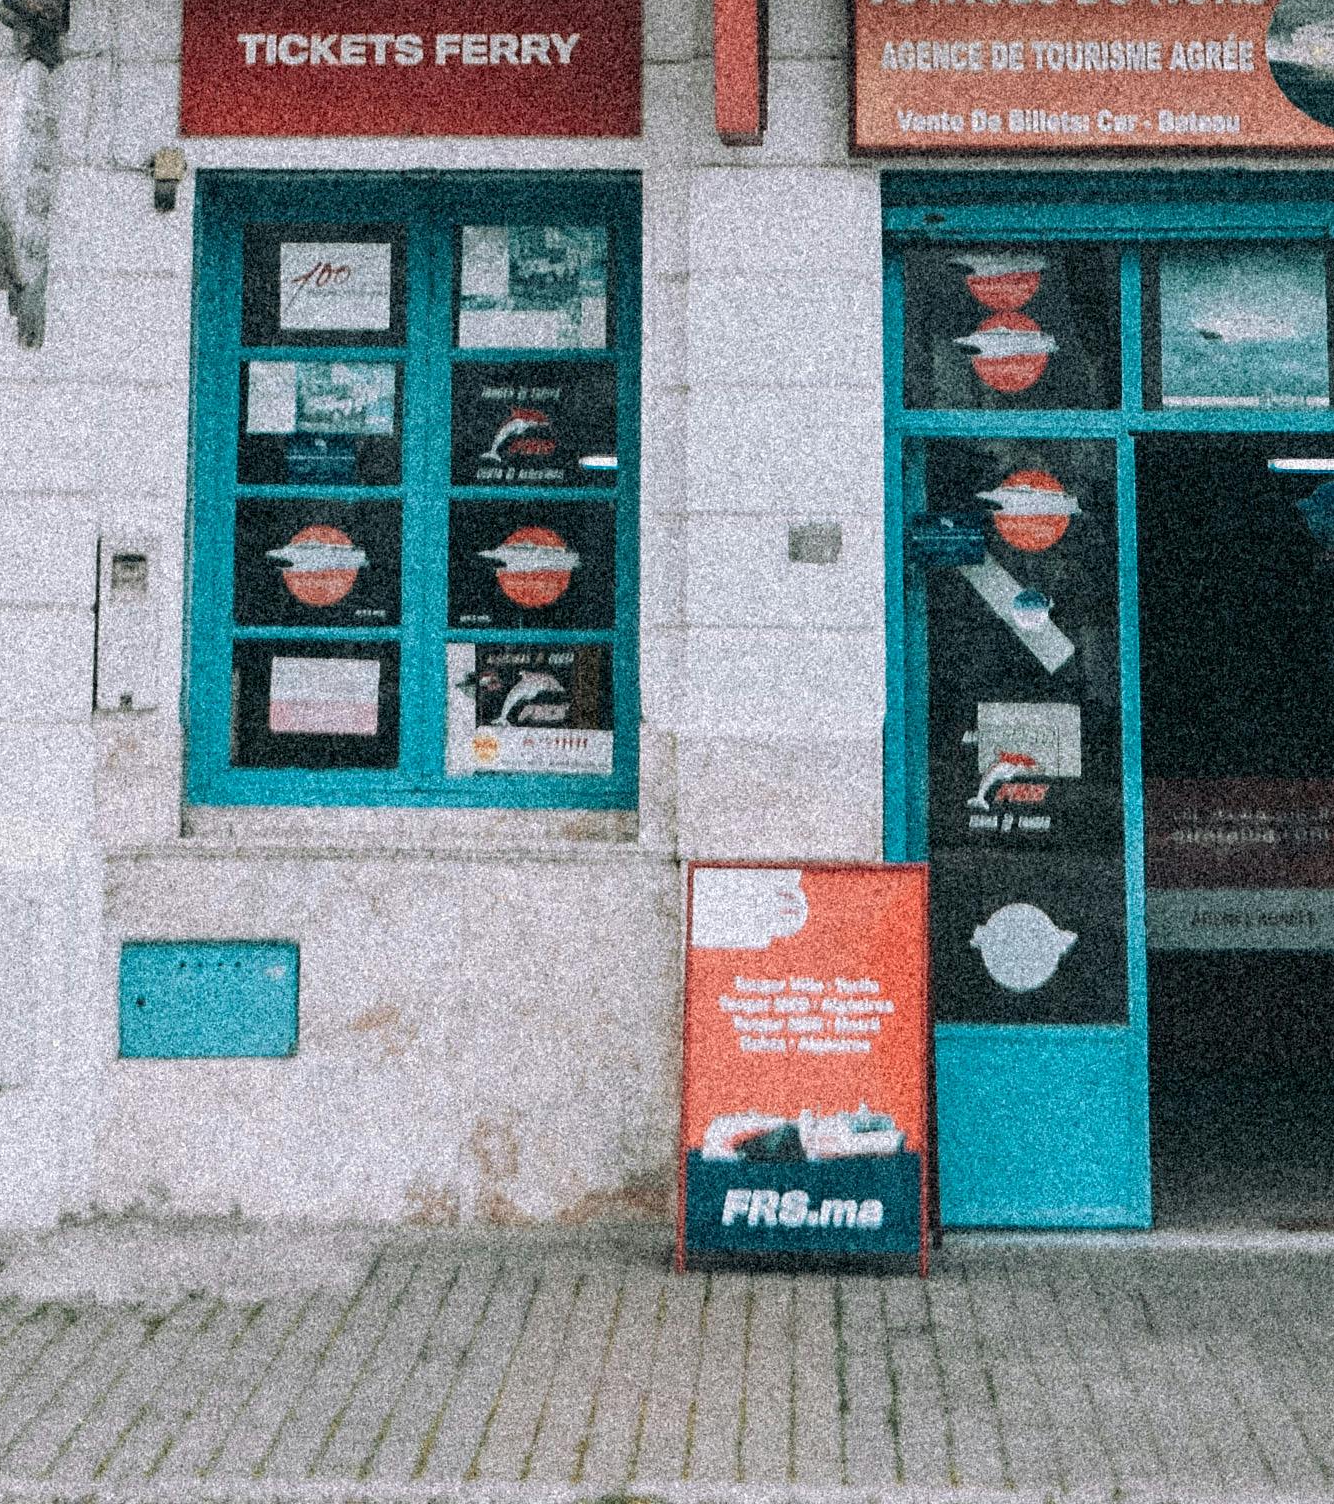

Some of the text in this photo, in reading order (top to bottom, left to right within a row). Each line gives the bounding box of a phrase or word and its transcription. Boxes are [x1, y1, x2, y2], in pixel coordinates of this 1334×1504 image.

[237, 33, 581, 66] TICKETS FERRY
[880, 33, 1255, 72] AGENCE DE TOURISME AGRÉE
[897, 110, 964, 133] Vente
[971, 110, 1002, 133] De
[1097, 110, 1138, 133] Car
[1158, 110, 1240, 134] Bateau
[722, 1188, 885, 1230] FRS.ma
